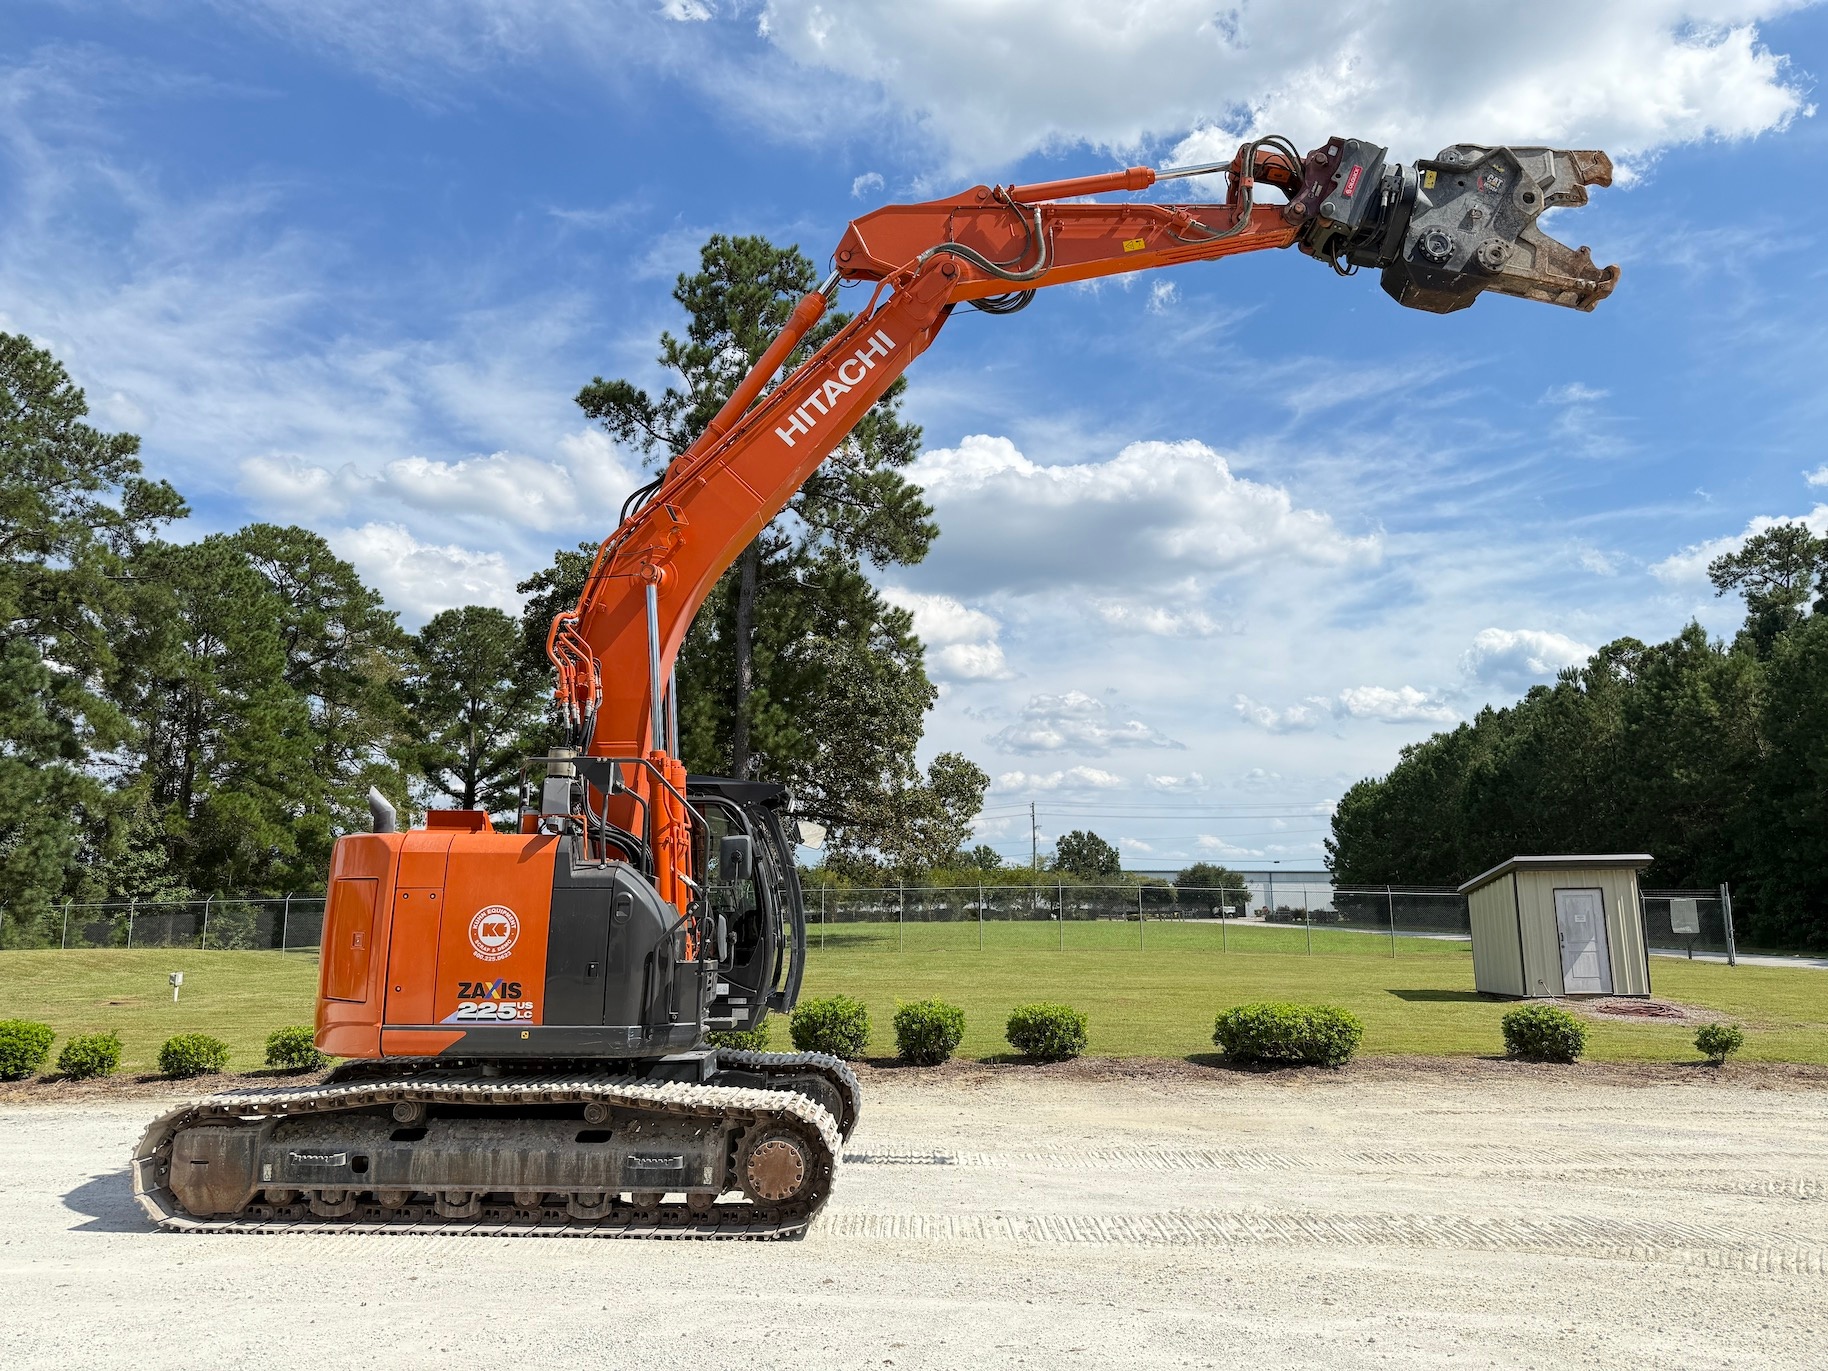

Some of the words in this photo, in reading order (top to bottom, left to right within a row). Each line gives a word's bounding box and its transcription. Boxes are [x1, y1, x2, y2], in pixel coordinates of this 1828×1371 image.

[1487, 174, 1504, 188] CAT
[774, 329, 896, 448] HITACHI
[472, 912, 487, 930] KUHN
[487, 908, 517, 929] EQUIPMENT
[474, 940, 491, 953] SCRAP
[497, 939, 512, 951] DEMO
[457, 979, 522, 1000] ZAXIS
[456, 1001, 517, 1021] 225
[517, 1001, 534, 1010] US
[517, 1010, 533, 1019] LC
